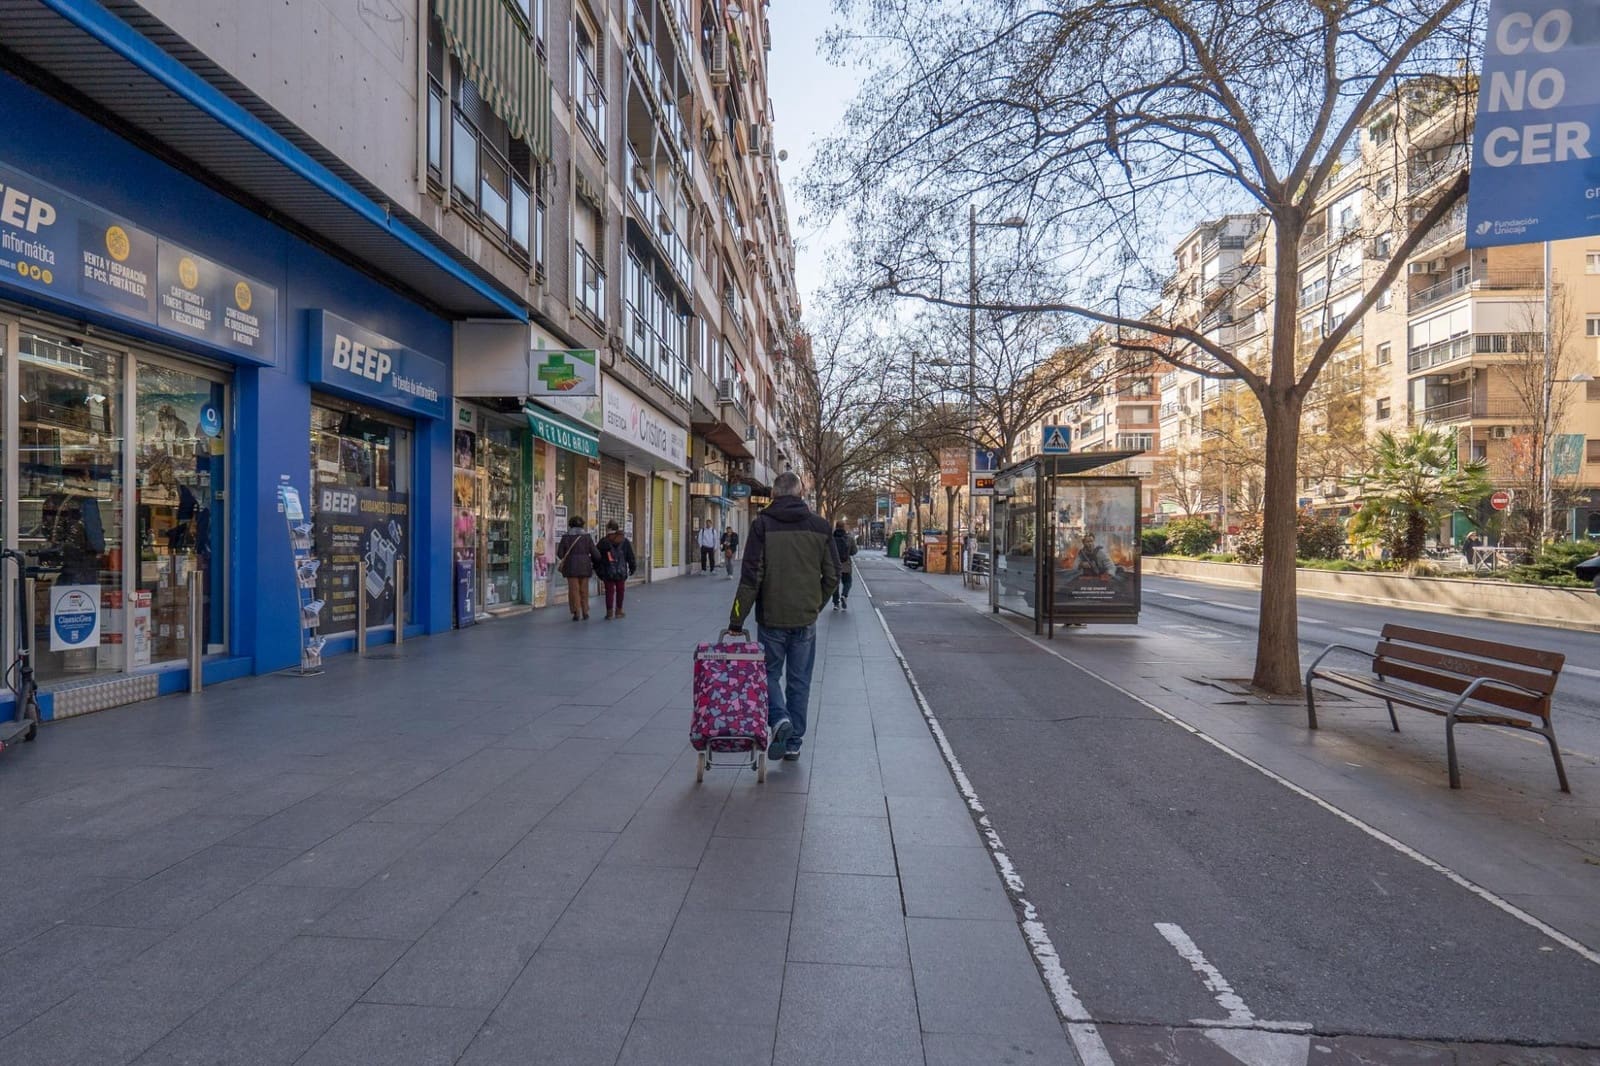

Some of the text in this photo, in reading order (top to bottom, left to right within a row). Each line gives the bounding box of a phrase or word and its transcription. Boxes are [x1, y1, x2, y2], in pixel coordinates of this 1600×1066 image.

[1496, 9, 1572, 55] CO
[1488, 67, 1566, 112] NO
[1483, 121, 1592, 167] CER
[0, 183, 57, 234] EP
[2, 229, 55, 266] informática
[83, 250, 104, 269] VENTA
[105, 259, 111, 271] Y
[84, 264, 94, 278] DE
[332, 334, 391, 383] BEEP
[640, 408, 666, 452] Cristina
[322, 490, 357, 513] BEEP
